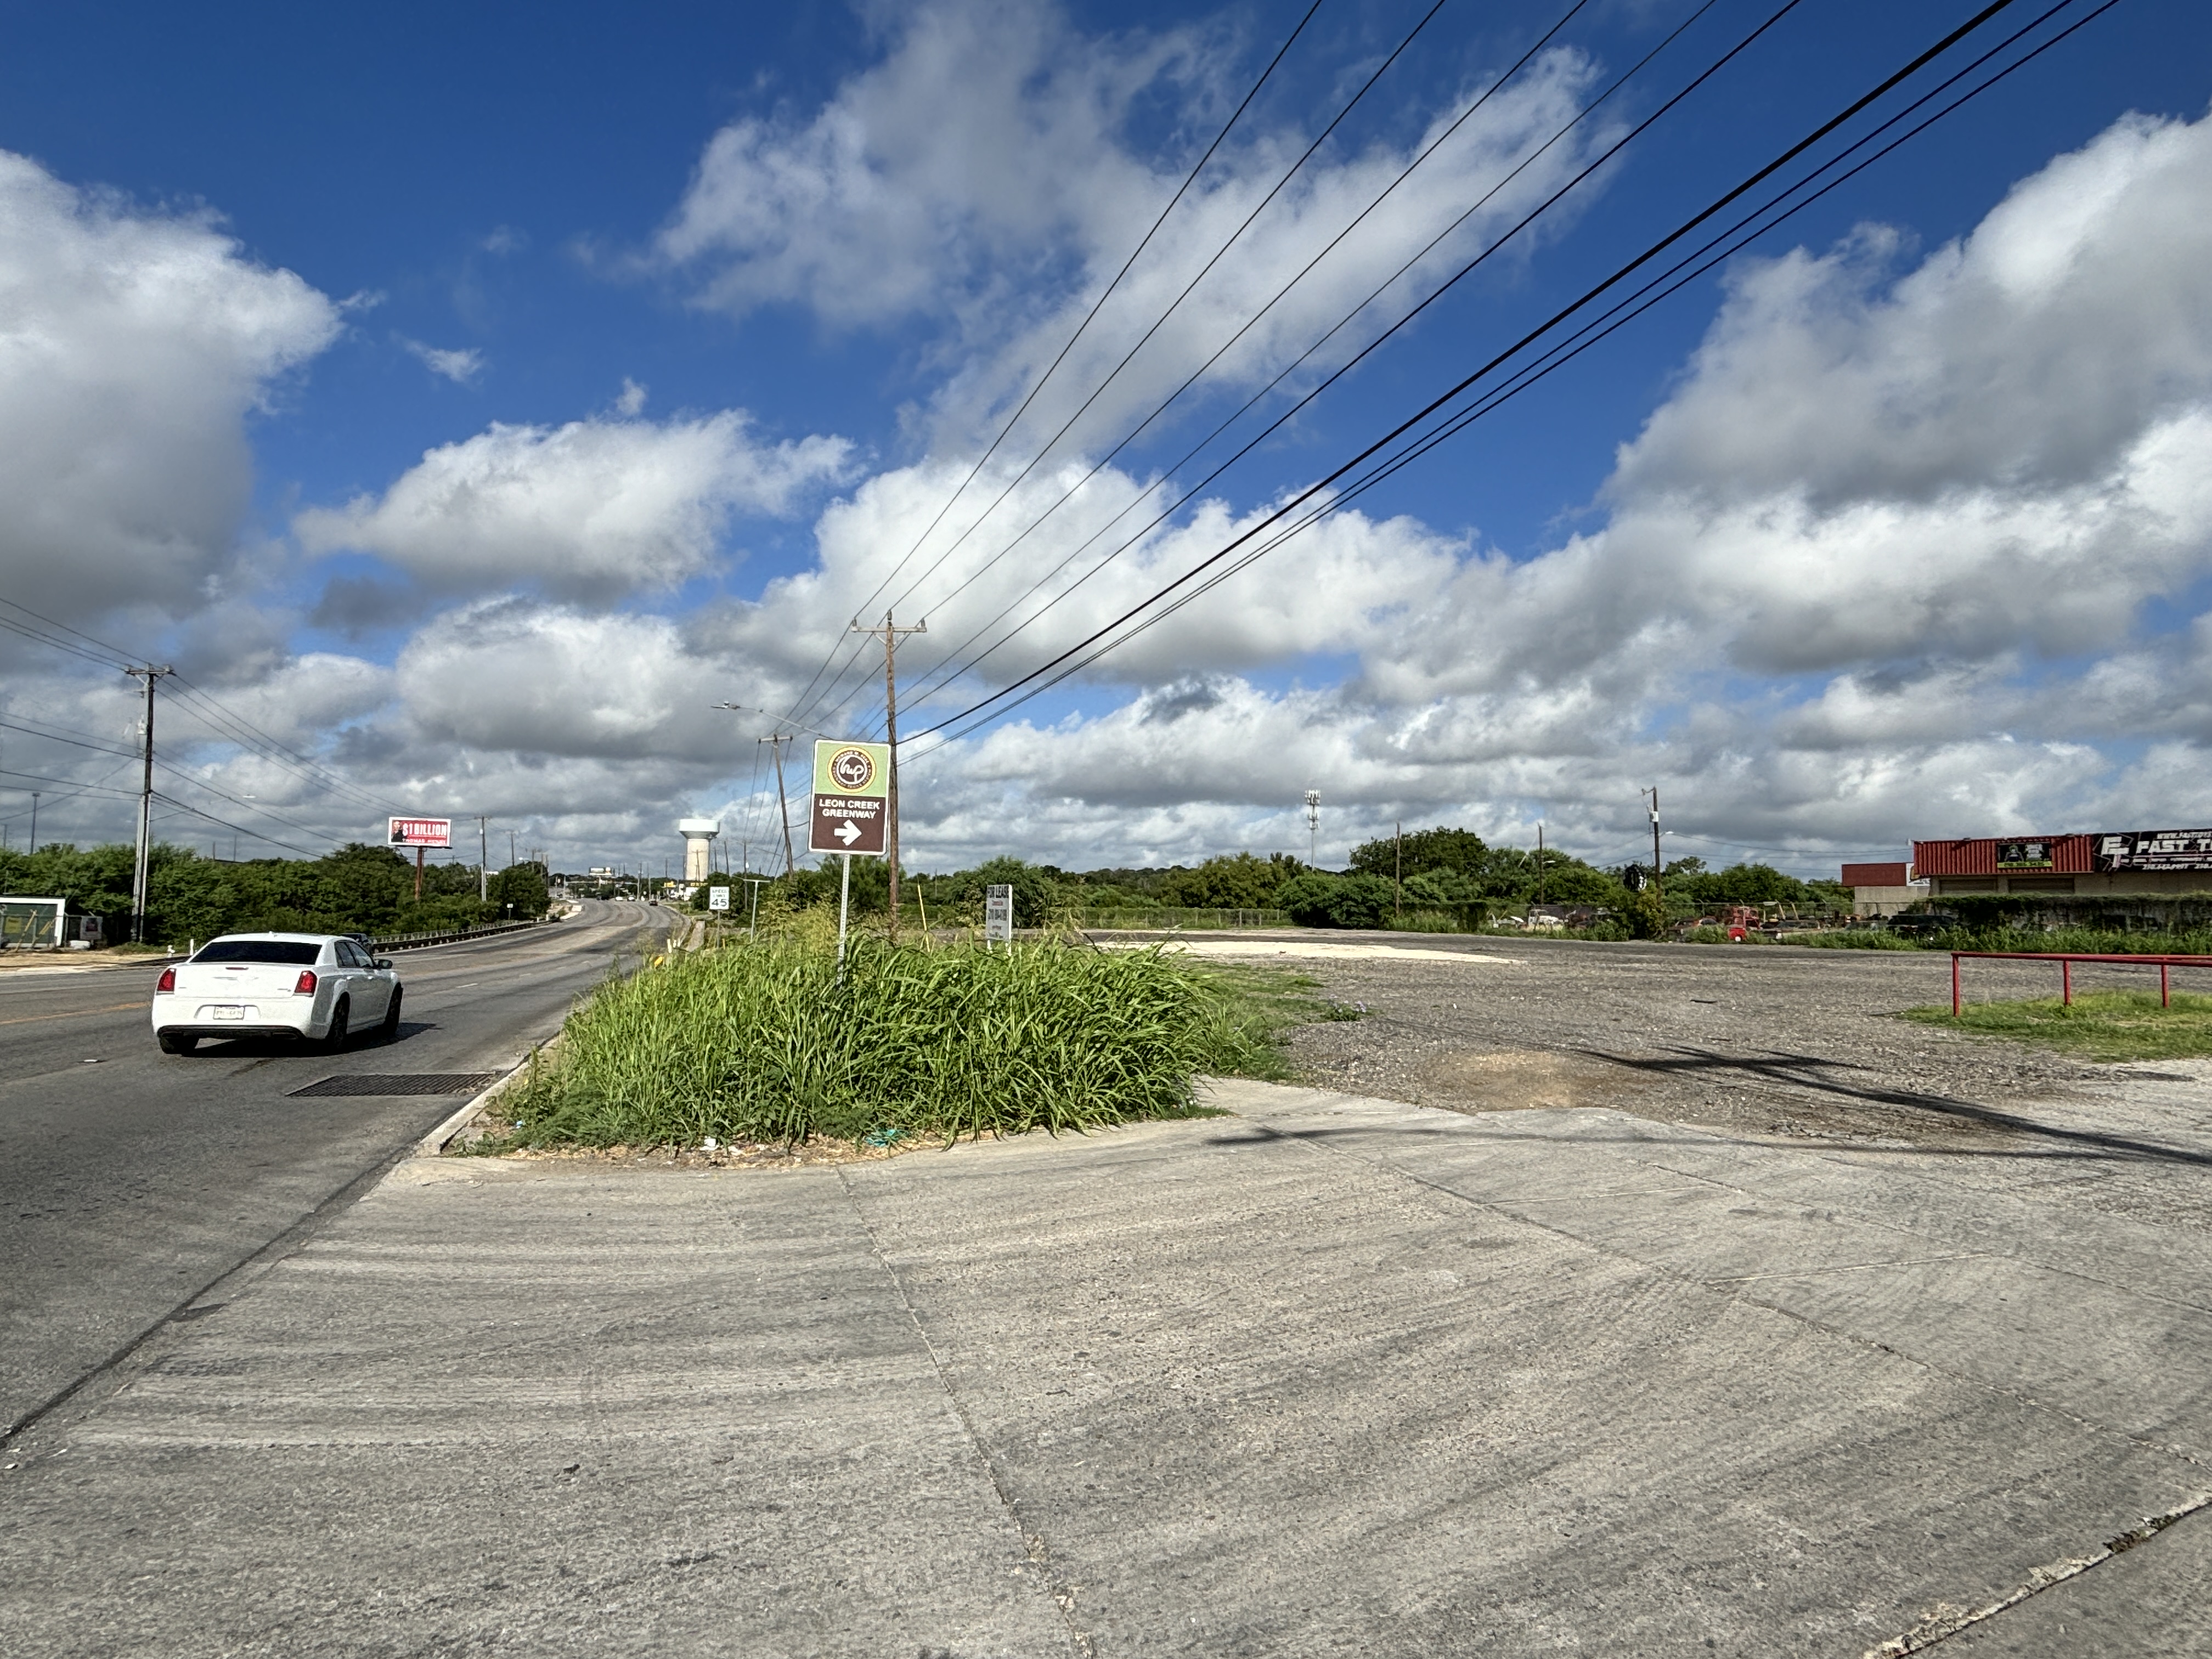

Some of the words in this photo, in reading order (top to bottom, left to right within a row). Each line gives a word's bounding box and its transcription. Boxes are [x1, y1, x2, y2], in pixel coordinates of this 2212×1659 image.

[819, 799, 845, 808] LEON
[847, 800, 880, 810] CREEK
[822, 809, 877, 819] GREENWAY
[403, 823, 413, 836] $1
[414, 823, 447, 836] BILLION
[2136, 840, 2189, 854] FAST
[2197, 838, 2212, 852] T
[996, 885, 1009, 898] LEASE
[712, 899, 727, 907] 45
